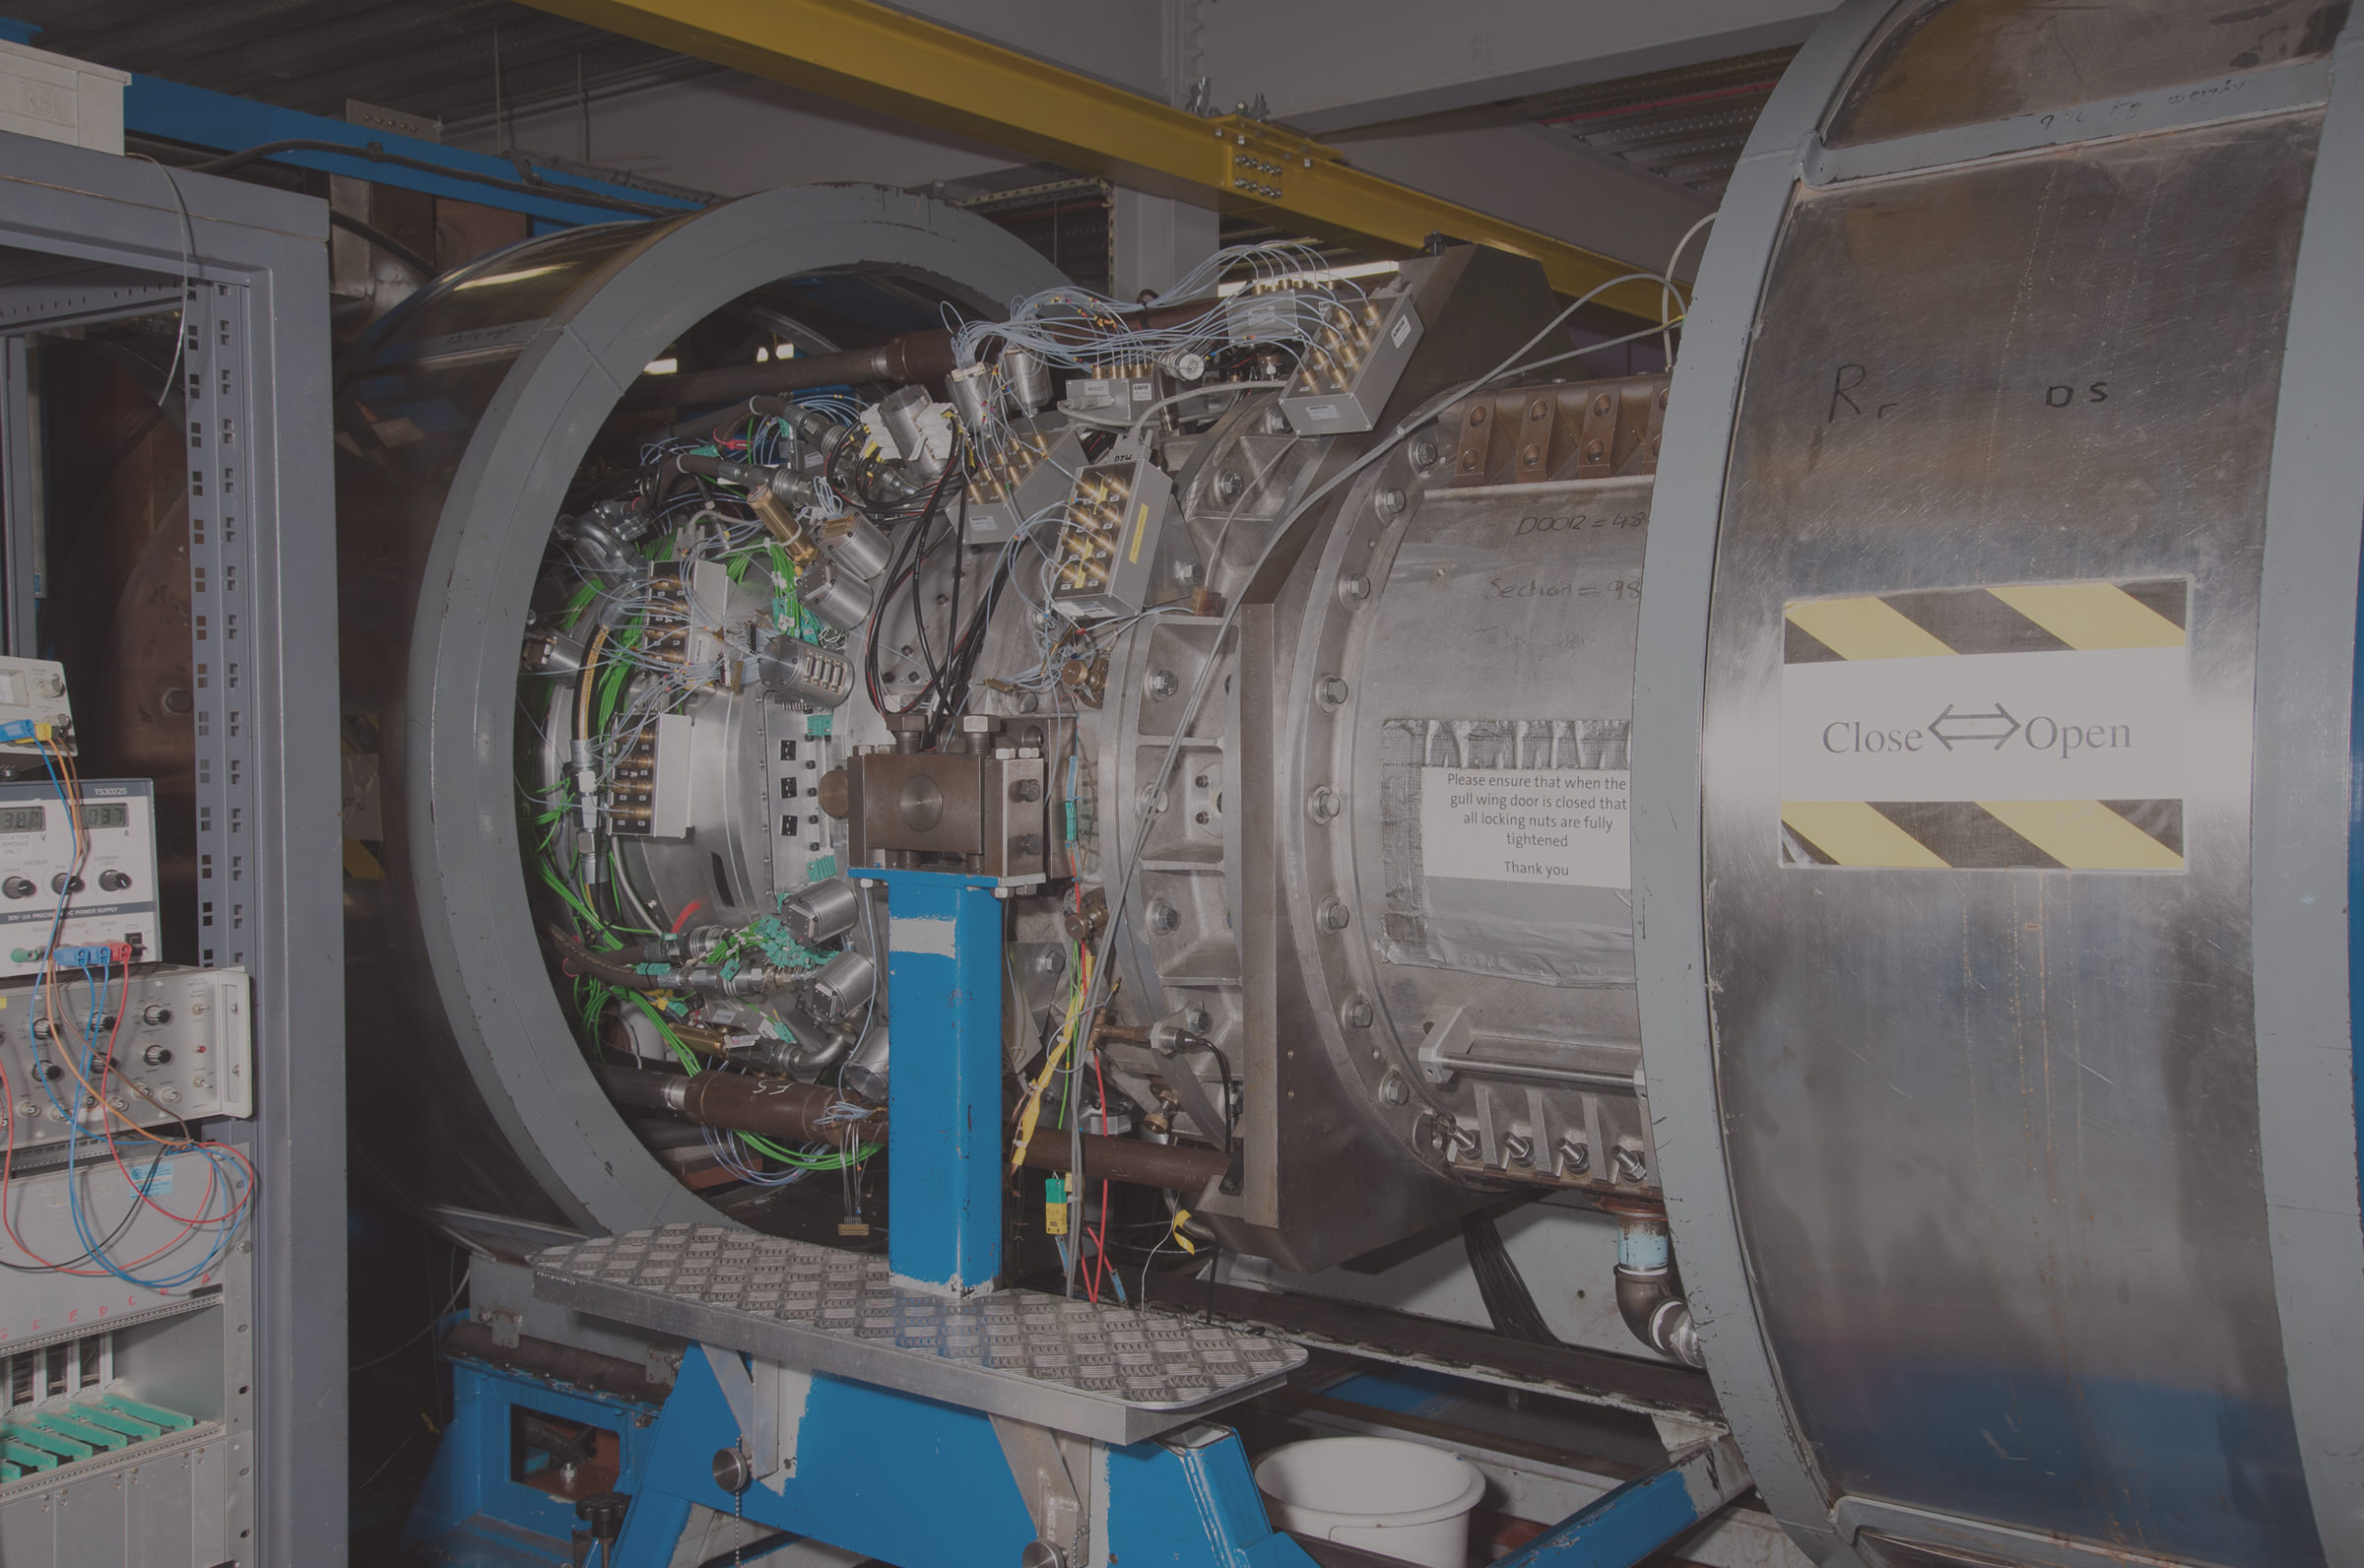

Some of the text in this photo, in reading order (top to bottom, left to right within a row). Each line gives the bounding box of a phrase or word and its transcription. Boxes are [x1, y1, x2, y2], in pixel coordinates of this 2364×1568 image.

[22, 86, 52, 114] RS
[1822, 716, 2133, 759] Close Open
[1447, 773, 1626, 790] Please ensure that when the
[1450, 792, 1627, 811] gull wing door is closed that
[1463, 812, 1613, 833] all locking nuts are fully
[1506, 832, 1568, 849] tightened
[1504, 861, 1569, 879] Thank you
[69, 1308, 79, 1323] E
[128, 1294, 137, 1306] C
